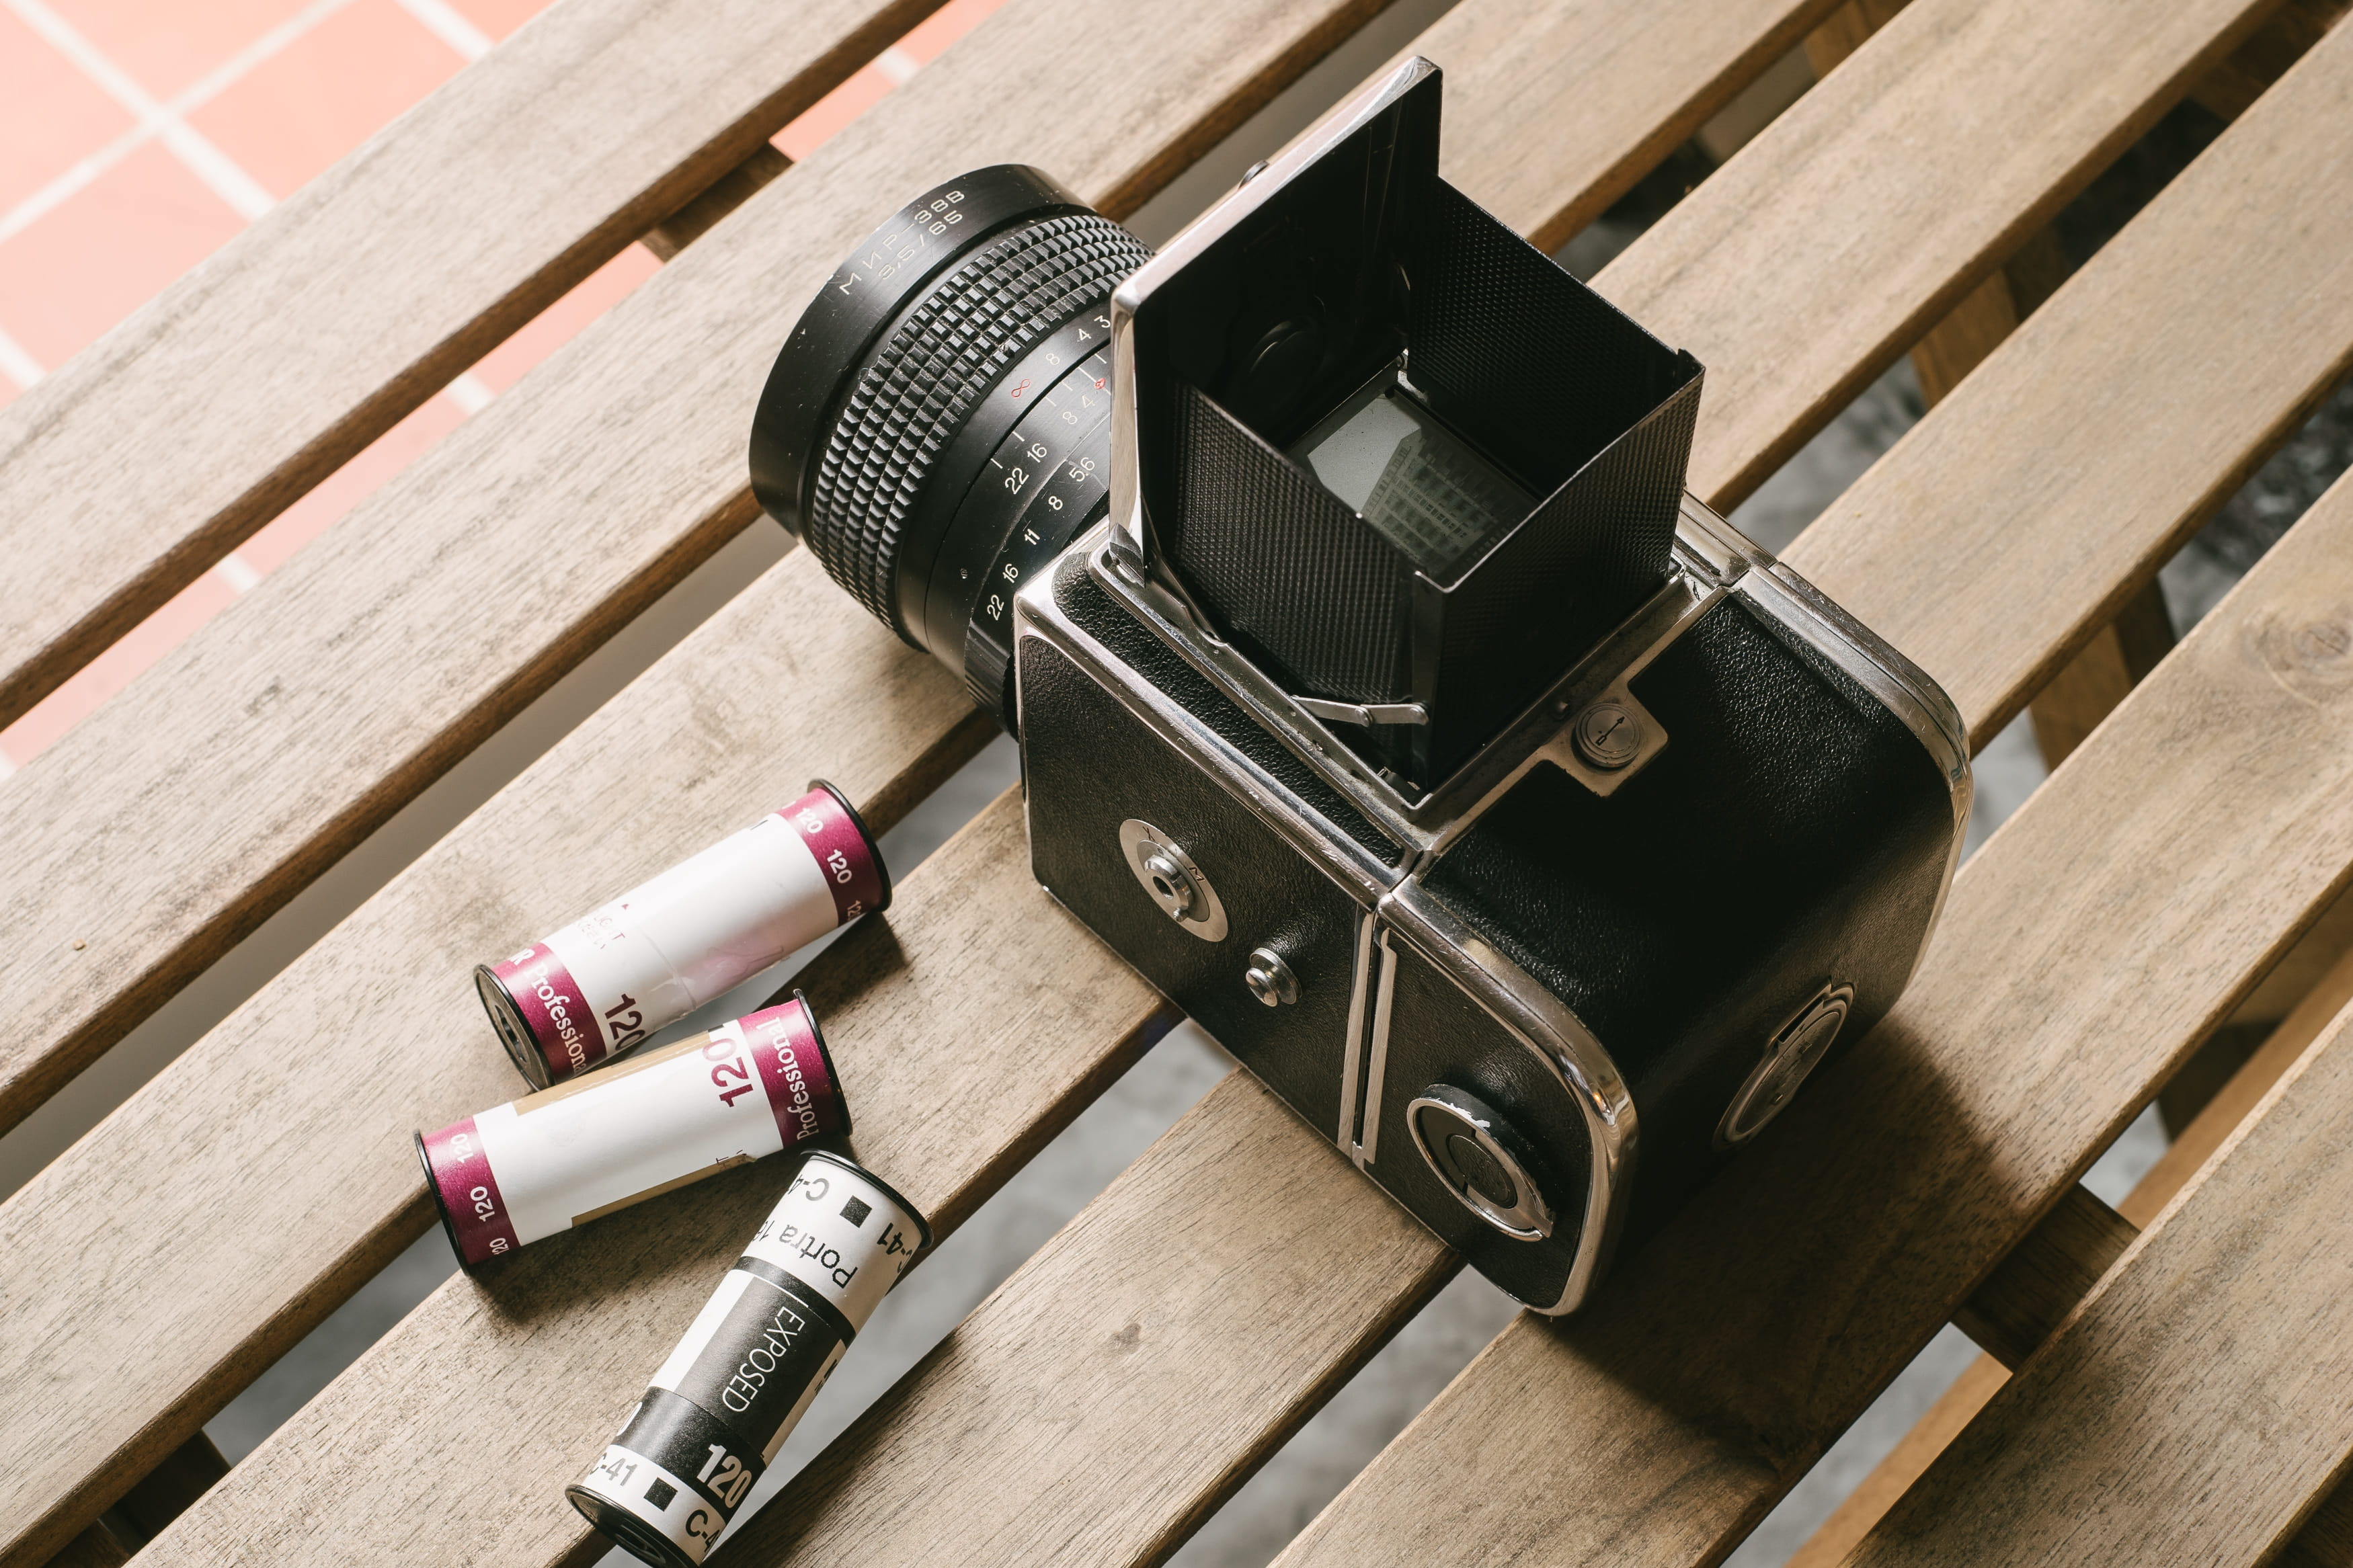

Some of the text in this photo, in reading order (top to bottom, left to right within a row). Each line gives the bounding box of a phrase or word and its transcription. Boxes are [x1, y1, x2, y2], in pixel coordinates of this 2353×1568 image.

[1045, 353, 1060, 366] 8
[1077, 328, 1092, 342] 4
[1004, 395, 1096, 495] 22 16 8 4
[987, 594, 1004, 620] 22
[1002, 563, 1019, 584] 16
[1024, 527, 1041, 546] 11
[1048, 495, 1064, 511] 8
[795, 807, 824, 834] 120
[827, 849, 852, 884] 120
[523, 962, 587, 1075] Professiona
[604, 993, 645, 1051] 120
[702, 1038, 754, 1108] 120
[756, 1016, 820, 1141] Professional
[450, 1133, 474, 1163] 120
[470, 1186, 495, 1222] 120
[788, 1175, 830, 1201] C-4
[779, 1224, 858, 1289] Portra
[722, 1306, 806, 1412] EXPOSED
[696, 1444, 752, 1509] 120
[685, 1509, 721, 1554] C-4
